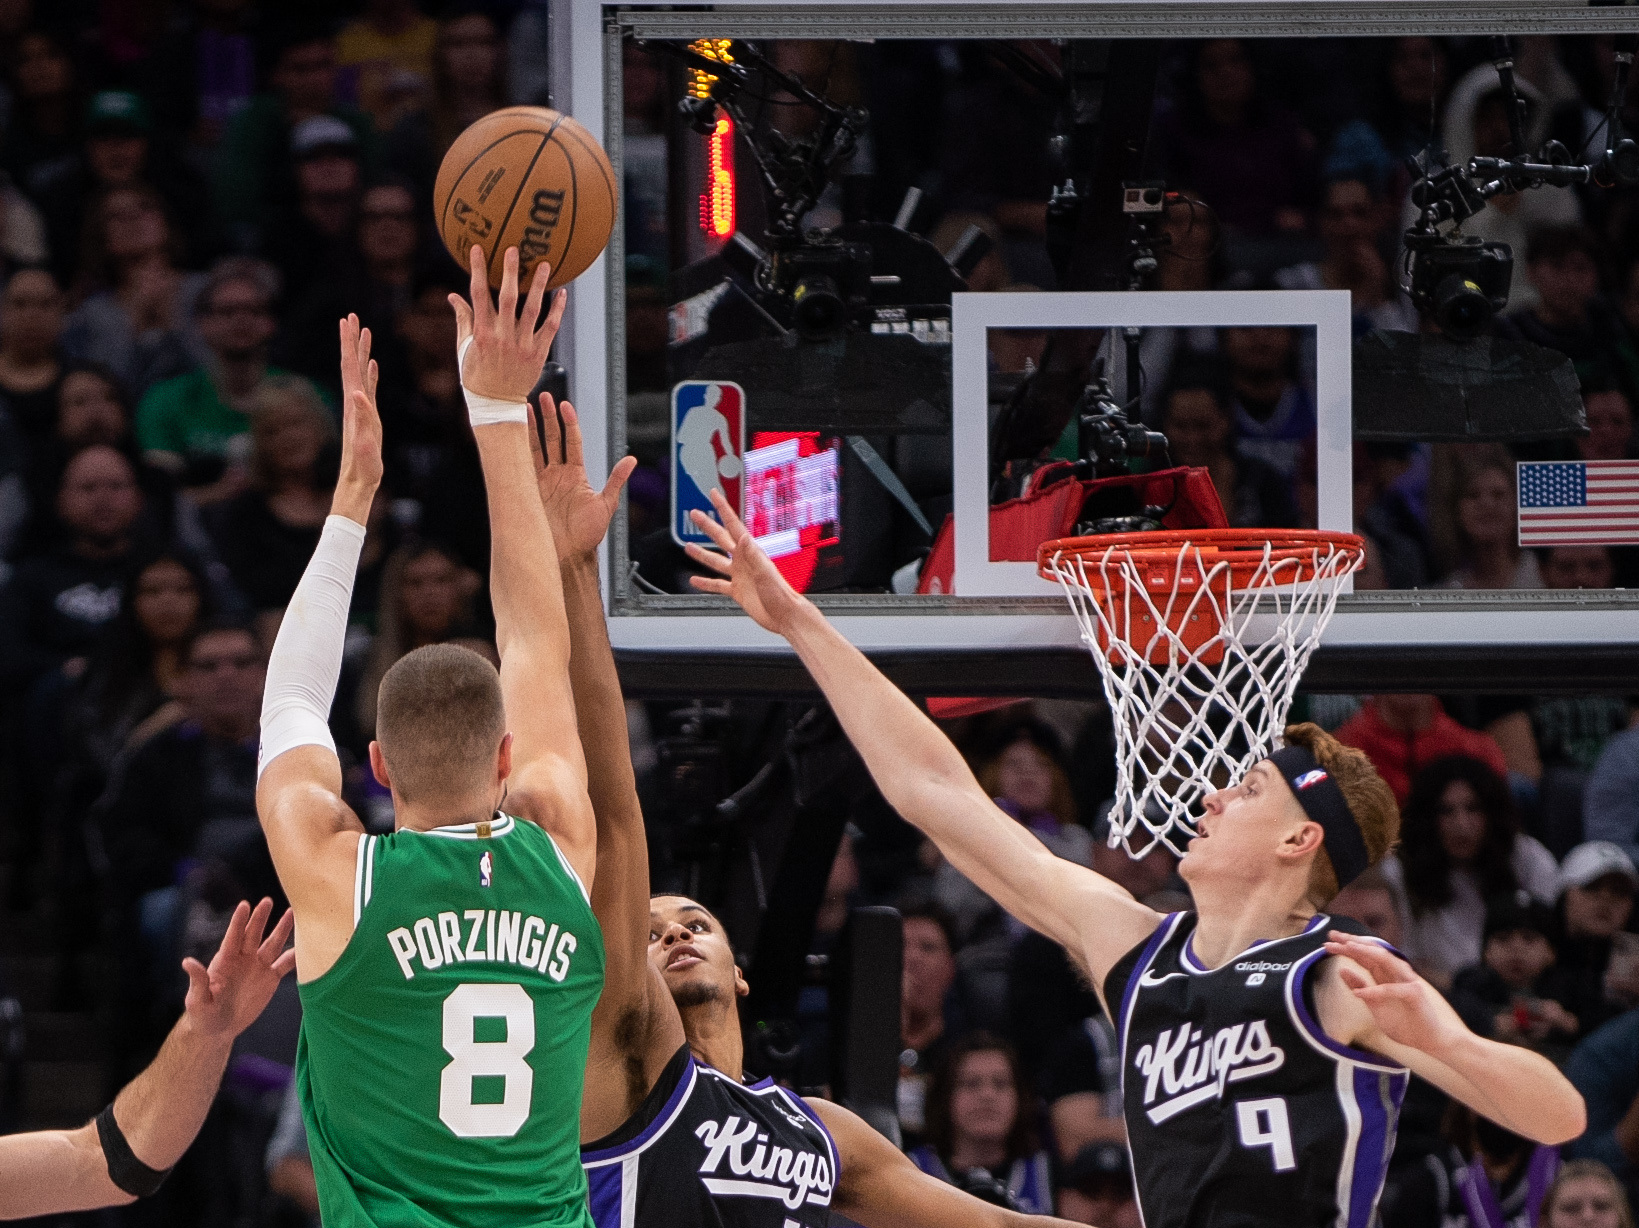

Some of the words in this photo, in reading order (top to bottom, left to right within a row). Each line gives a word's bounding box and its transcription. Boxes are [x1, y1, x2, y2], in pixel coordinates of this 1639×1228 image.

[387, 909, 577, 982] PORZINGIS
[1235, 961, 1292, 972] dialpad
[439, 983, 535, 1137] 8
[1135, 1020, 1285, 1124] Kings
[695, 1116, 832, 1209] Kings
[1236, 1097, 1296, 1173] 9
